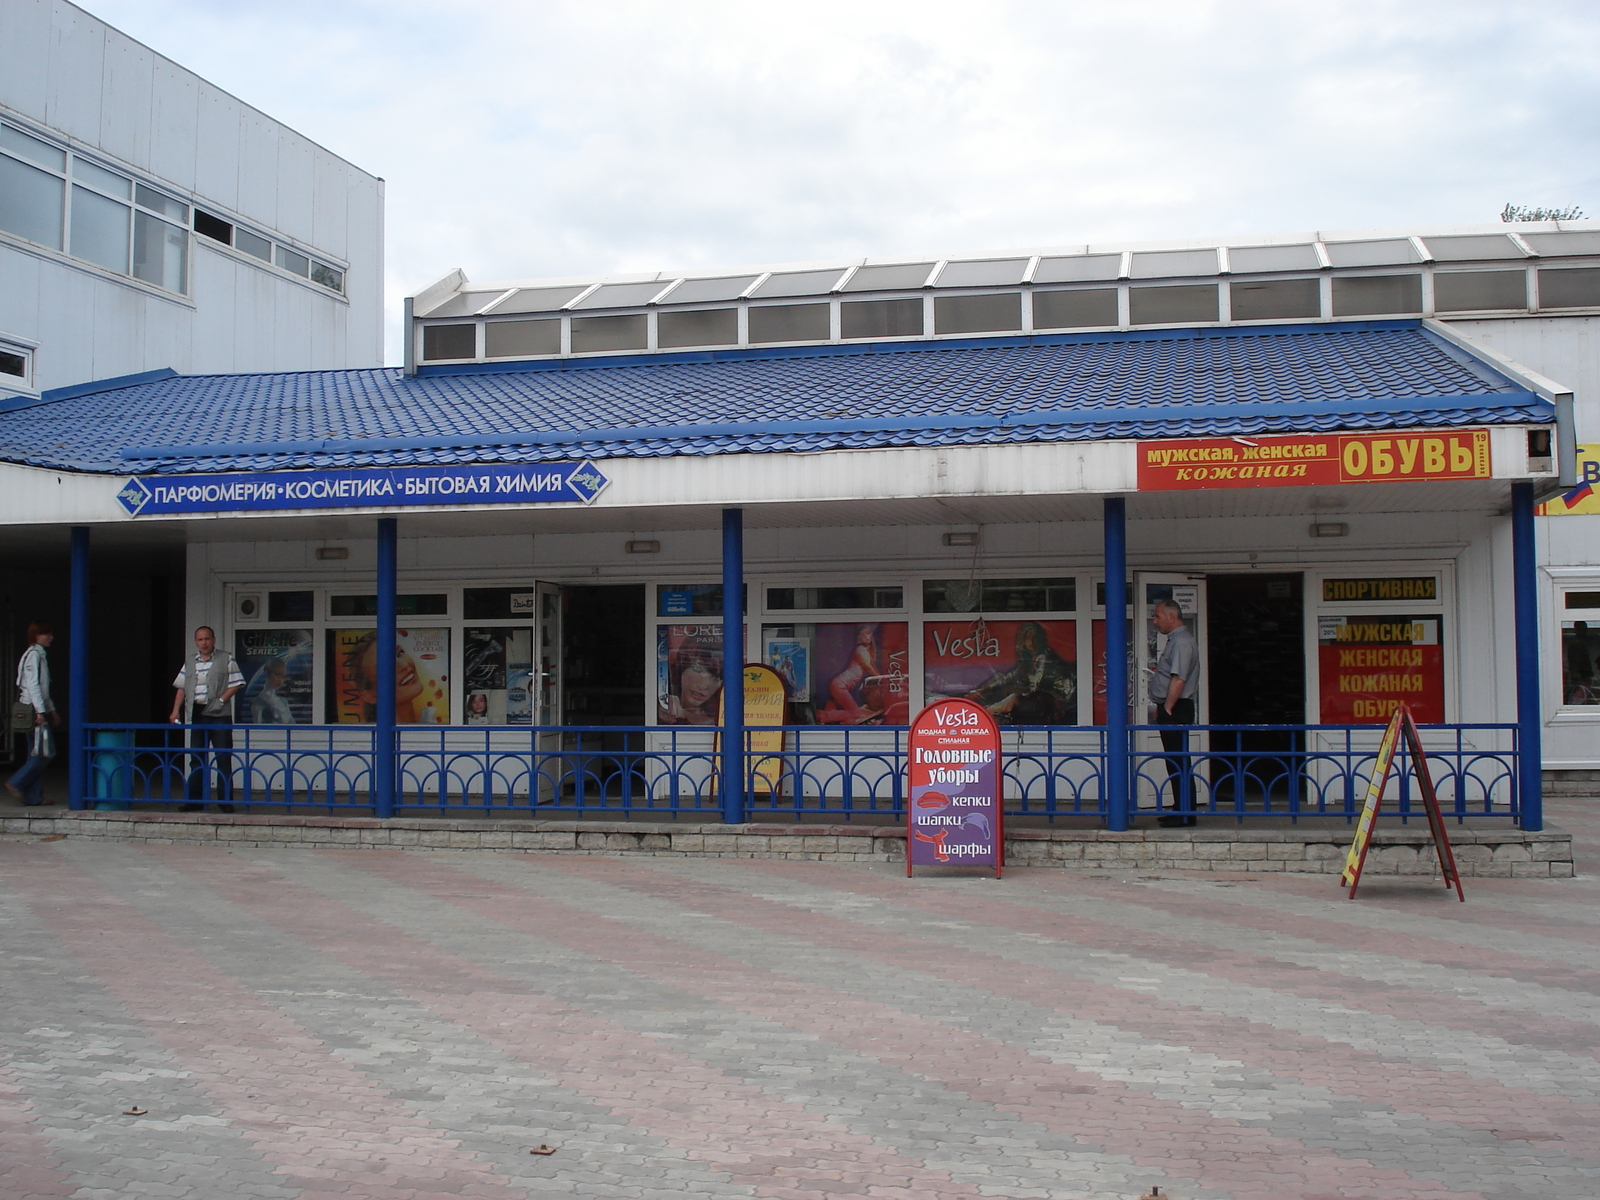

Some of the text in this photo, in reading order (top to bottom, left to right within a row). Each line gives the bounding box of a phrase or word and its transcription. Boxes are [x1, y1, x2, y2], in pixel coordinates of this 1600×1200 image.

[1242, 443, 1328, 460] женская
[1343, 437, 1473, 476] ОБУВЬ
[1175, 464, 1308, 481] кожаная
[154, 473, 562, 504] ПАРФЮМЕРИЯ КОСМЕТИКА БЫТОВАЯ ХИМИЯ
[1323, 579, 1435, 600] СПОРТИВНАЯ
[1336, 624, 1424, 642] МУЖСКАЯ
[933, 628, 1000, 659] Vesta
[1339, 648, 1423, 667] ЖЕНСКАЯ
[888, 650, 908, 693] Vesta
[1339, 674, 1423, 692] КОЖАНАЯ
[934, 707, 979, 727] Vesta
[1353, 699, 1406, 718] ОБУВ
[915, 747, 992, 764] Головные
[928, 767, 979, 786] уборы
[952, 796, 991, 807] кепки
[917, 815, 962, 826] шапки
[938, 842, 991, 858] шарфы
